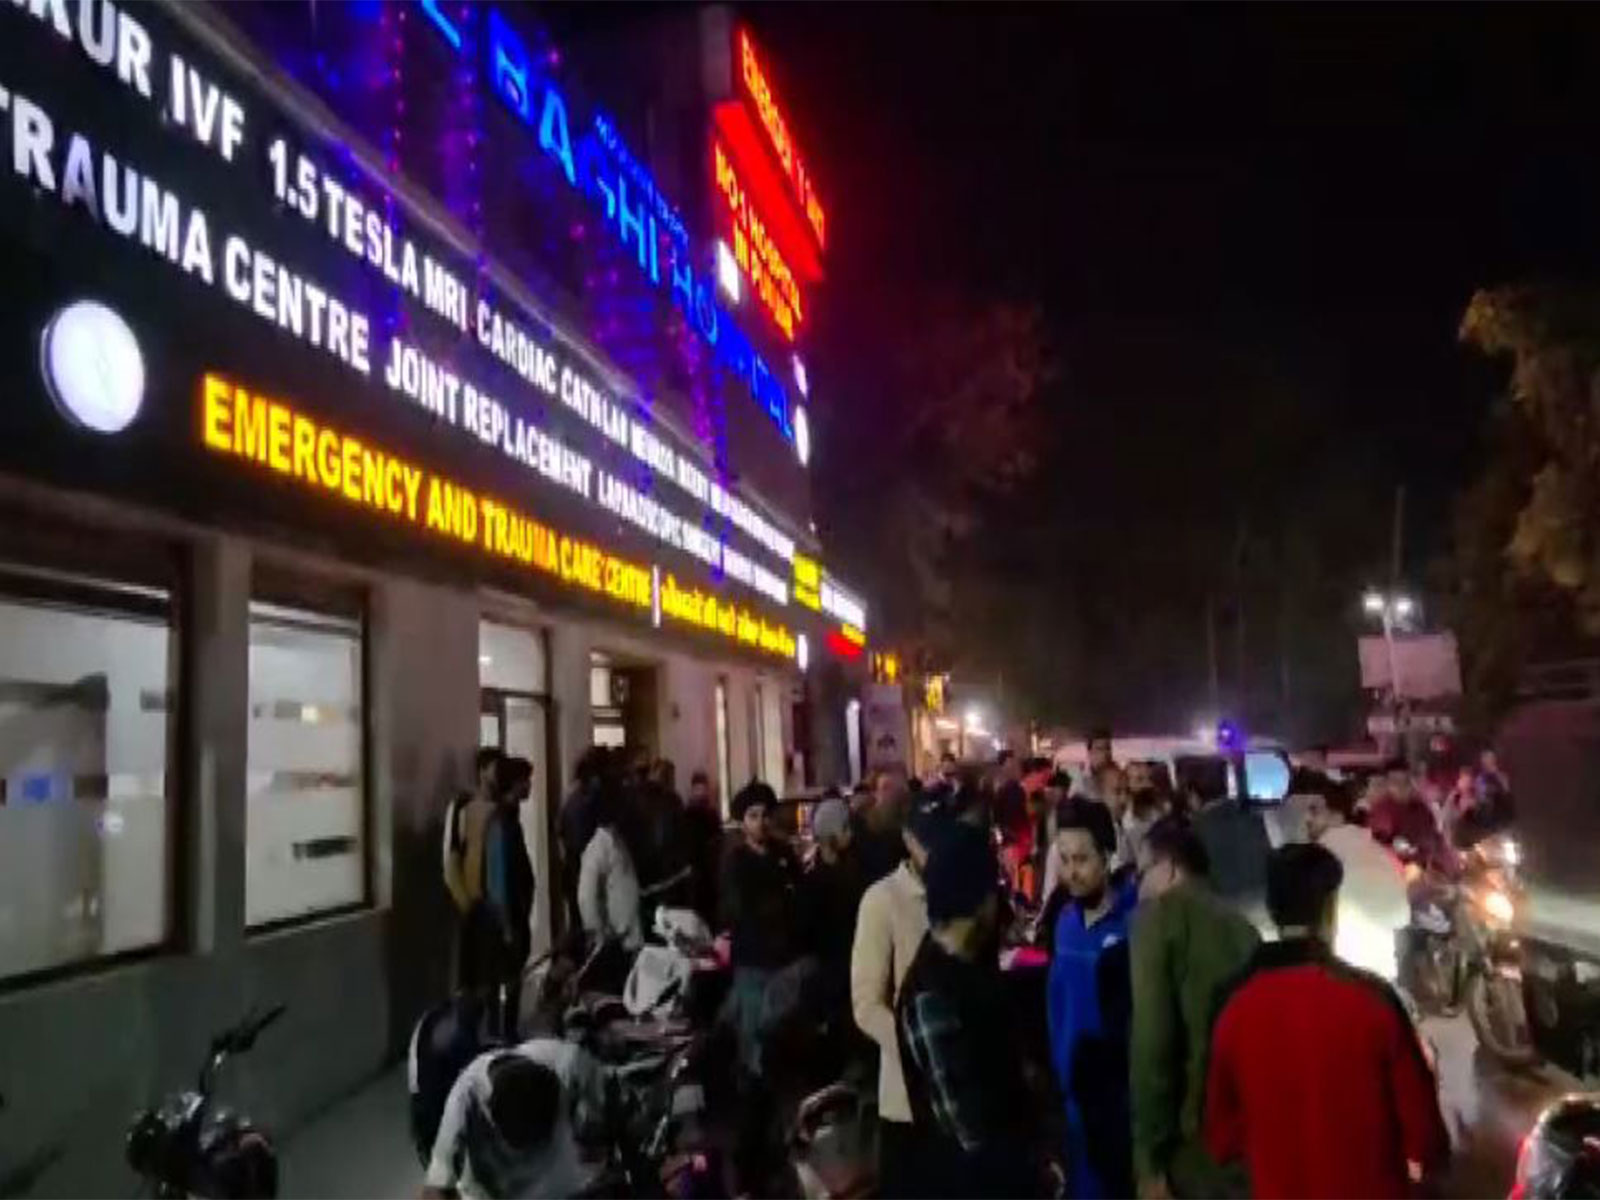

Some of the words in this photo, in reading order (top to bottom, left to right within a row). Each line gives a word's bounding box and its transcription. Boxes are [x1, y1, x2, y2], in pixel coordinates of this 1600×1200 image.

[170, 53, 245, 162] IVF
[269, 139, 318, 220] 1.5
[321, 173, 420, 297] TESLA
[424, 255, 468, 332] MRI
[476, 299, 556, 394] CARDIAC
[203, 373, 422, 521] EMERGENCY
[427, 475, 479, 543] AND
[481, 498, 557, 571] TRAUMA
[225, 236, 371, 375] CENTRE
[385, 337, 460, 424] JOINT
[463, 382, 591, 498] REPLACEMENT
